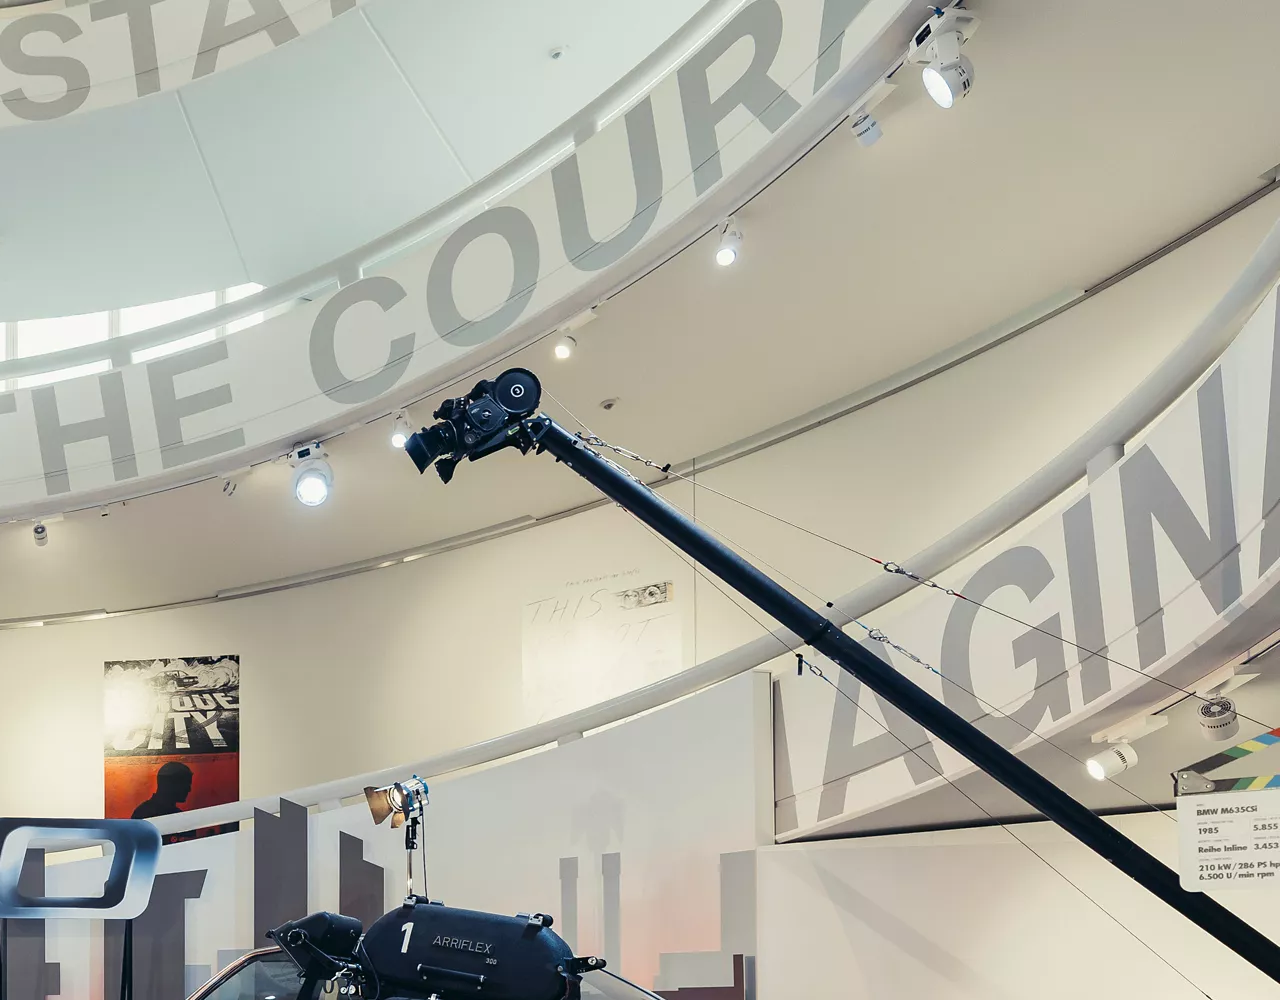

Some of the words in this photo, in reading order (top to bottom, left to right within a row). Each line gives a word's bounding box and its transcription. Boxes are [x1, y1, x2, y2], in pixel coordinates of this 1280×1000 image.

[773, 283, 1280, 829] AGIN
[526, 588, 609, 625] THIS
[1196, 808, 1218, 816] BMW
[1220, 805, 1258, 814] M635CSi
[1253, 823, 1278, 831] 5.855
[1224, 844, 1248, 852] Inline
[1254, 842, 1279, 850] 3.453
[1199, 864, 1215, 872] 210
[401, 921, 414, 954] 1
[432, 935, 492, 954] ARRIFLEX
